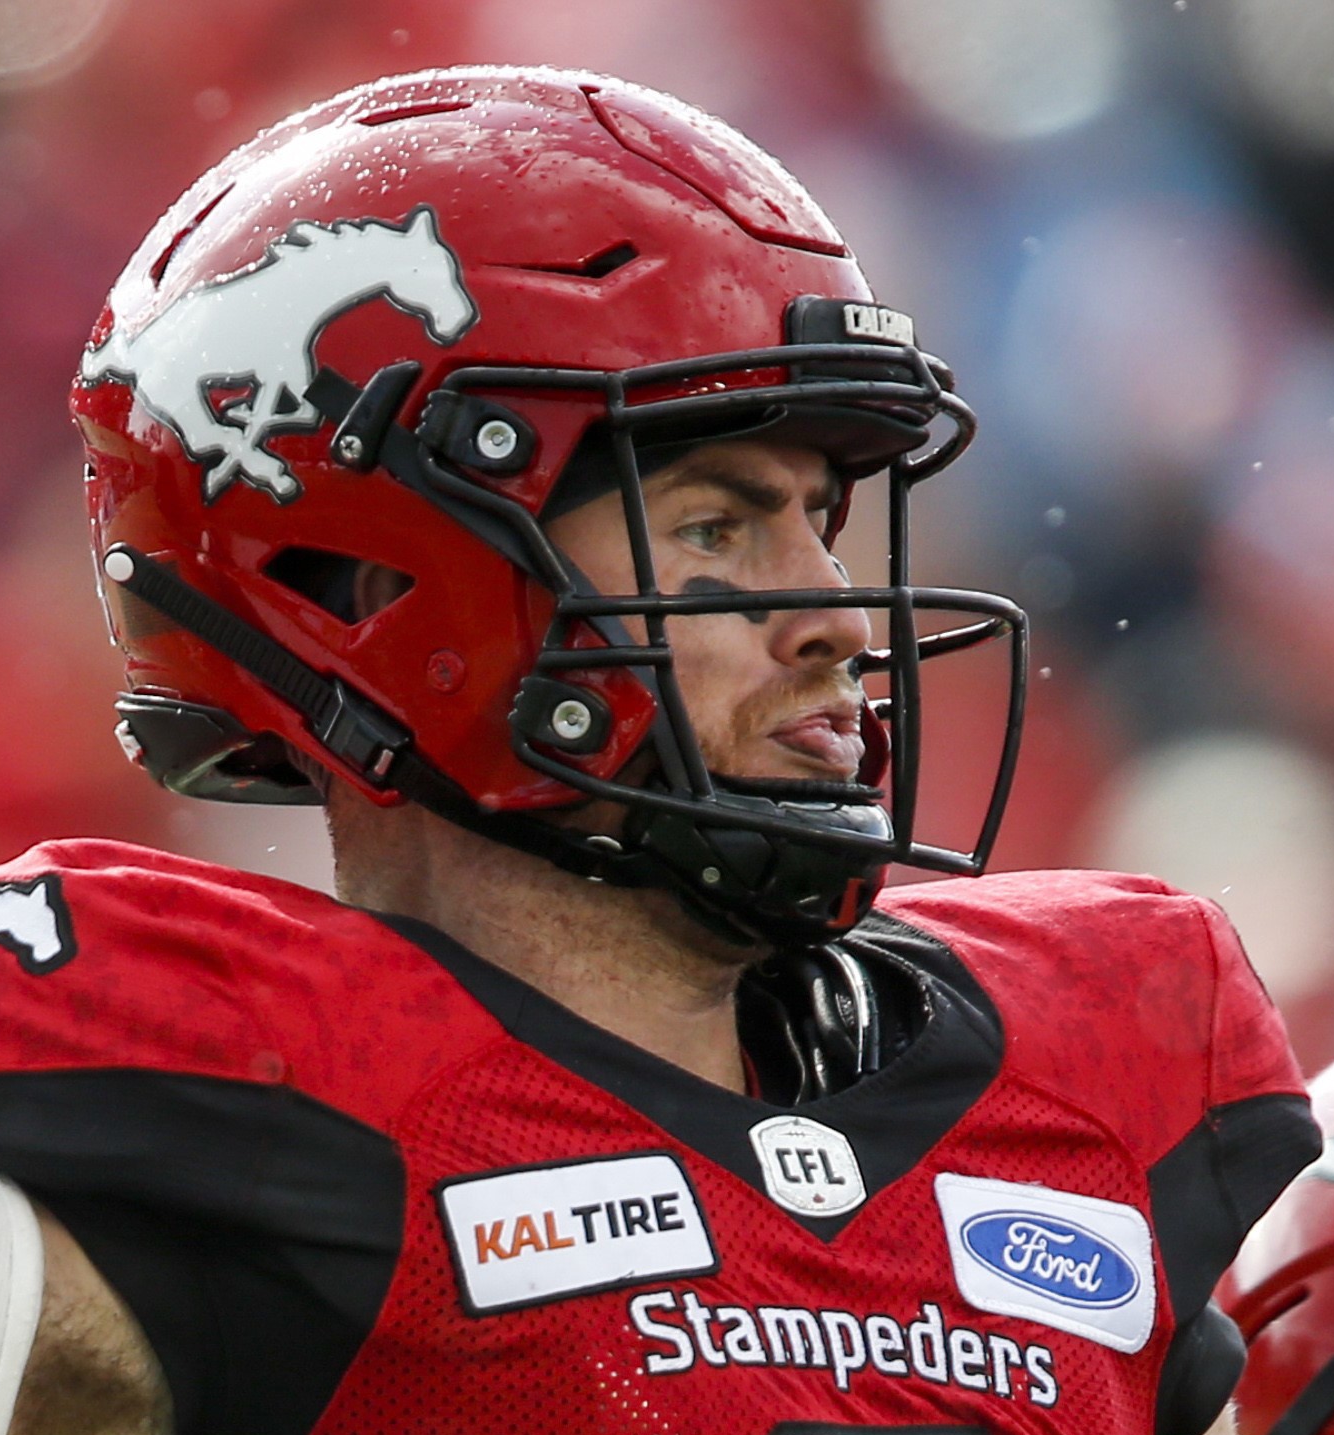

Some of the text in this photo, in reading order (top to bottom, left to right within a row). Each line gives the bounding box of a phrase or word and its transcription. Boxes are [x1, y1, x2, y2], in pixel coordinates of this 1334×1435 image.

[776, 1145, 846, 1187] CFL
[1004, 1220, 1102, 1293] Ford
[629, 1291, 1060, 1408] Stampeders
